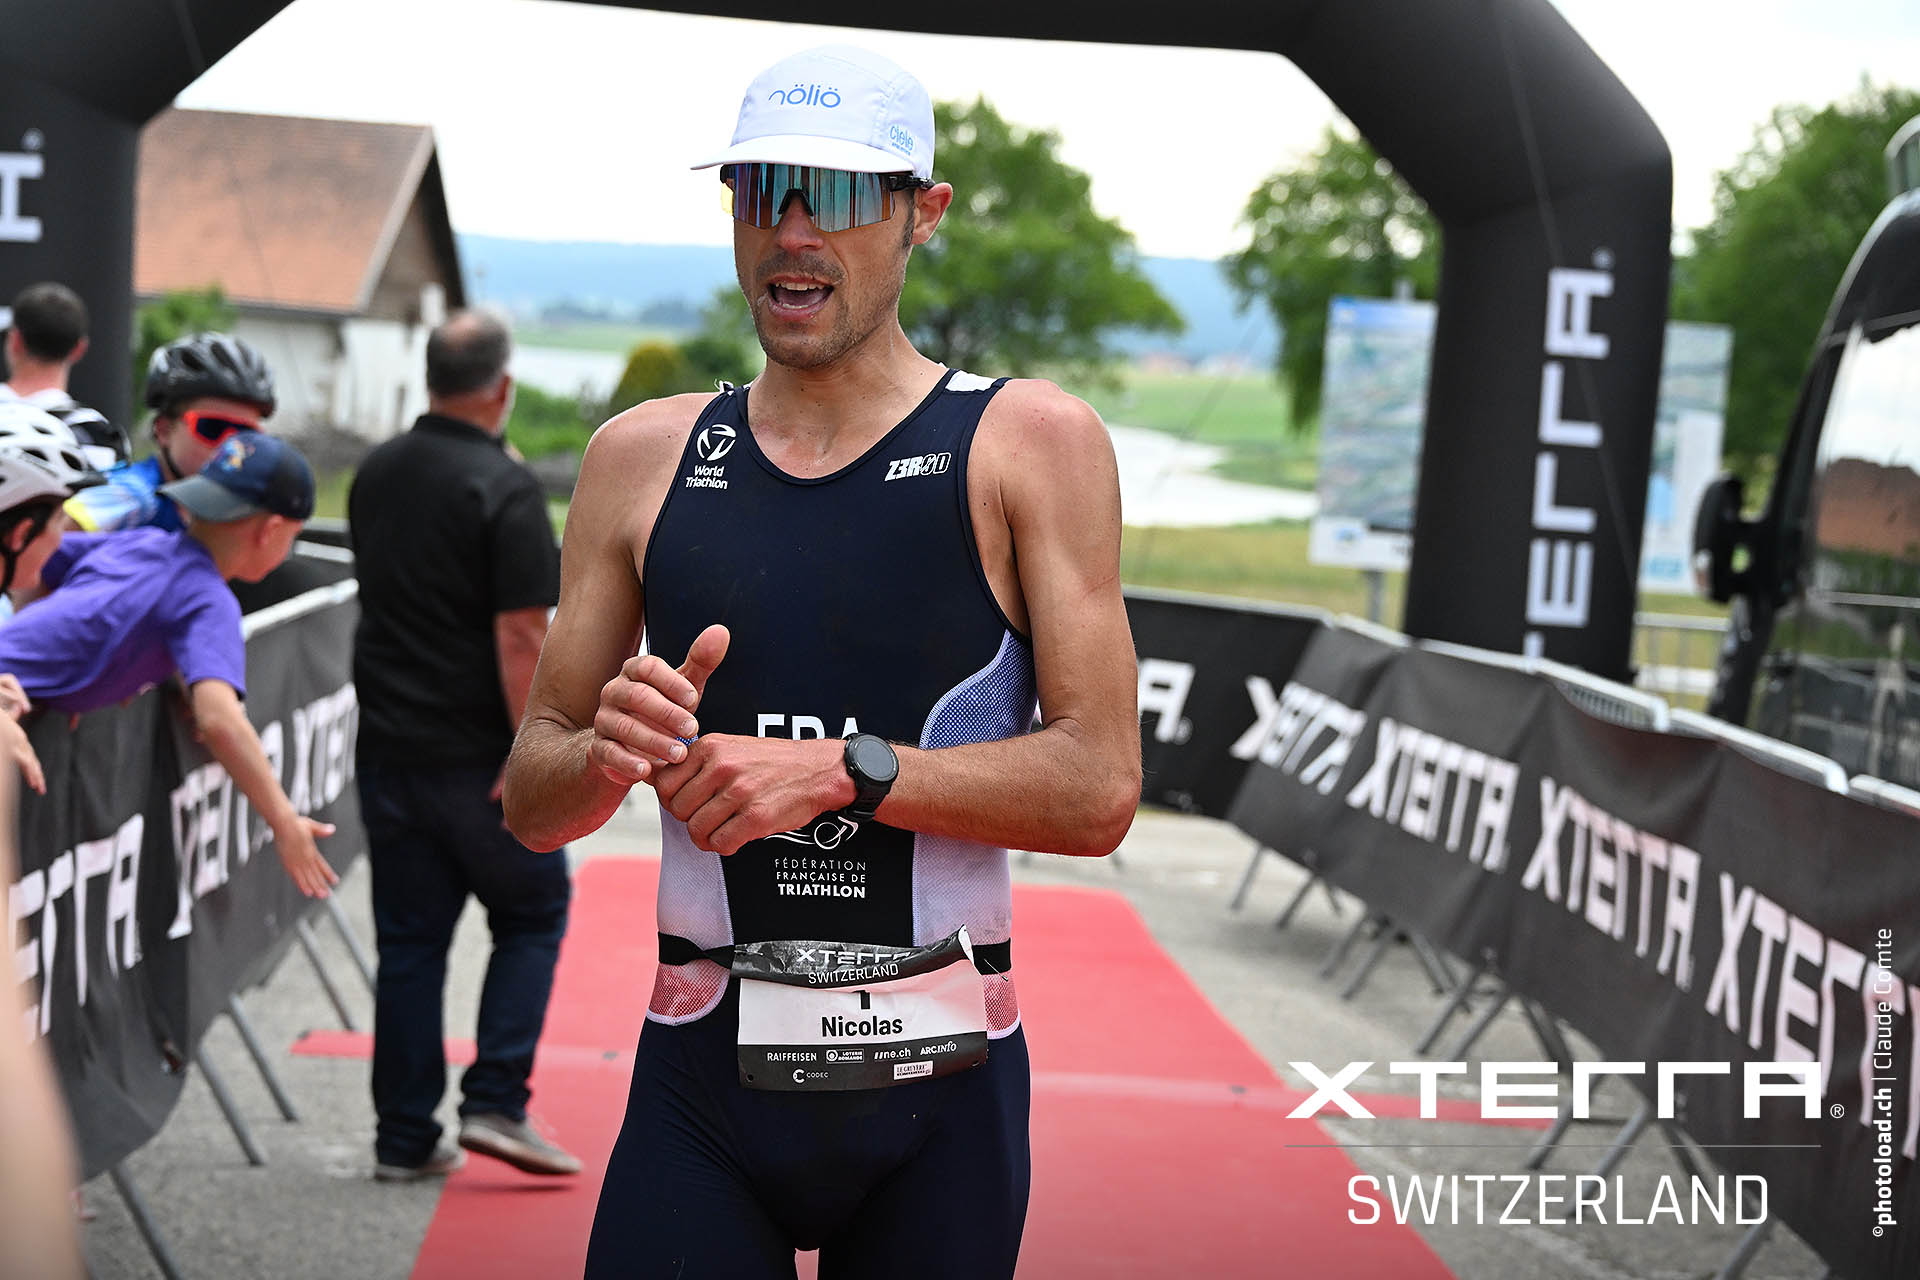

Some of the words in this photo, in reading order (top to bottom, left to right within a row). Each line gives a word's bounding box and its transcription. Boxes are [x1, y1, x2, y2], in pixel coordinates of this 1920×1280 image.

[694, 465, 724, 477] World
[685, 476, 728, 490] Triathlon
[1346, 718, 1519, 871] XTERRA
[775, 857, 866, 871] FÉDÉRATION
[776, 871, 845, 883] FRANÇAISE
[851, 874, 866, 883] DE
[1521, 776, 1700, 990] XTERRA
[777, 884, 866, 899] TRIATHLON
[808, 963, 899, 985] SWITZERLAND
[1705, 872, 1920, 1160] XTERR
[821, 1016, 903, 1037] Nicolas
[767, 1052, 817, 1062] RAIFFEISEN
